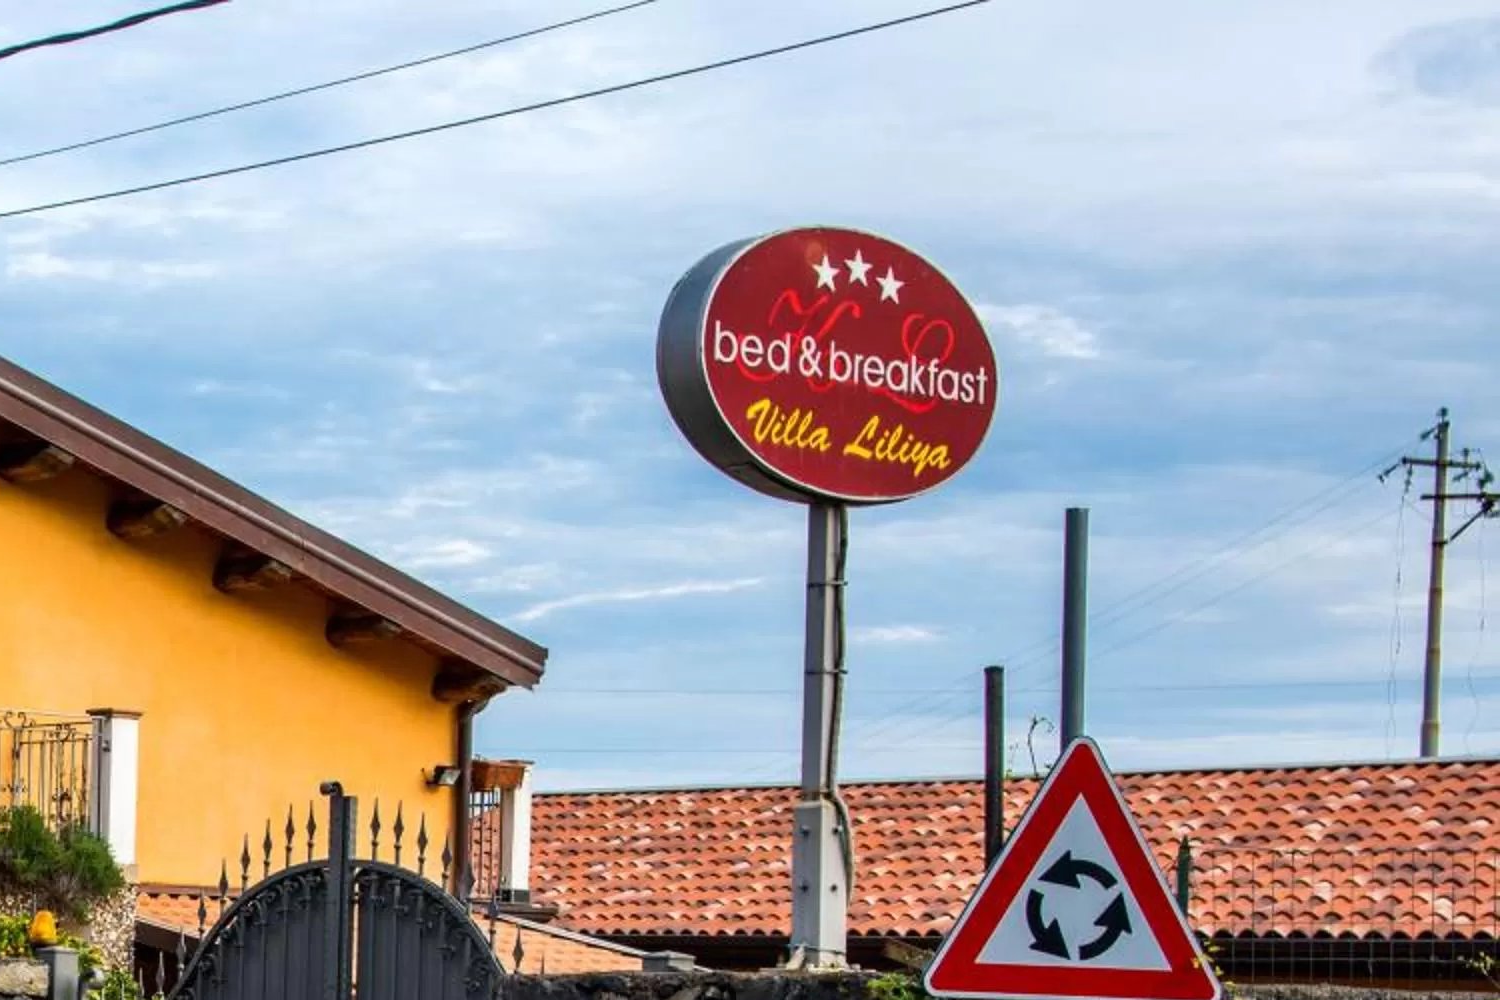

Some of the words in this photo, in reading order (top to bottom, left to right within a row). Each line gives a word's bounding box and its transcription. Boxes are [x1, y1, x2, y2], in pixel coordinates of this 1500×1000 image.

[713, 320, 792, 374] bed
[829, 341, 988, 405] breakfast
[746, 398, 832, 452] Villa
[843, 415, 952, 477] Liliya
